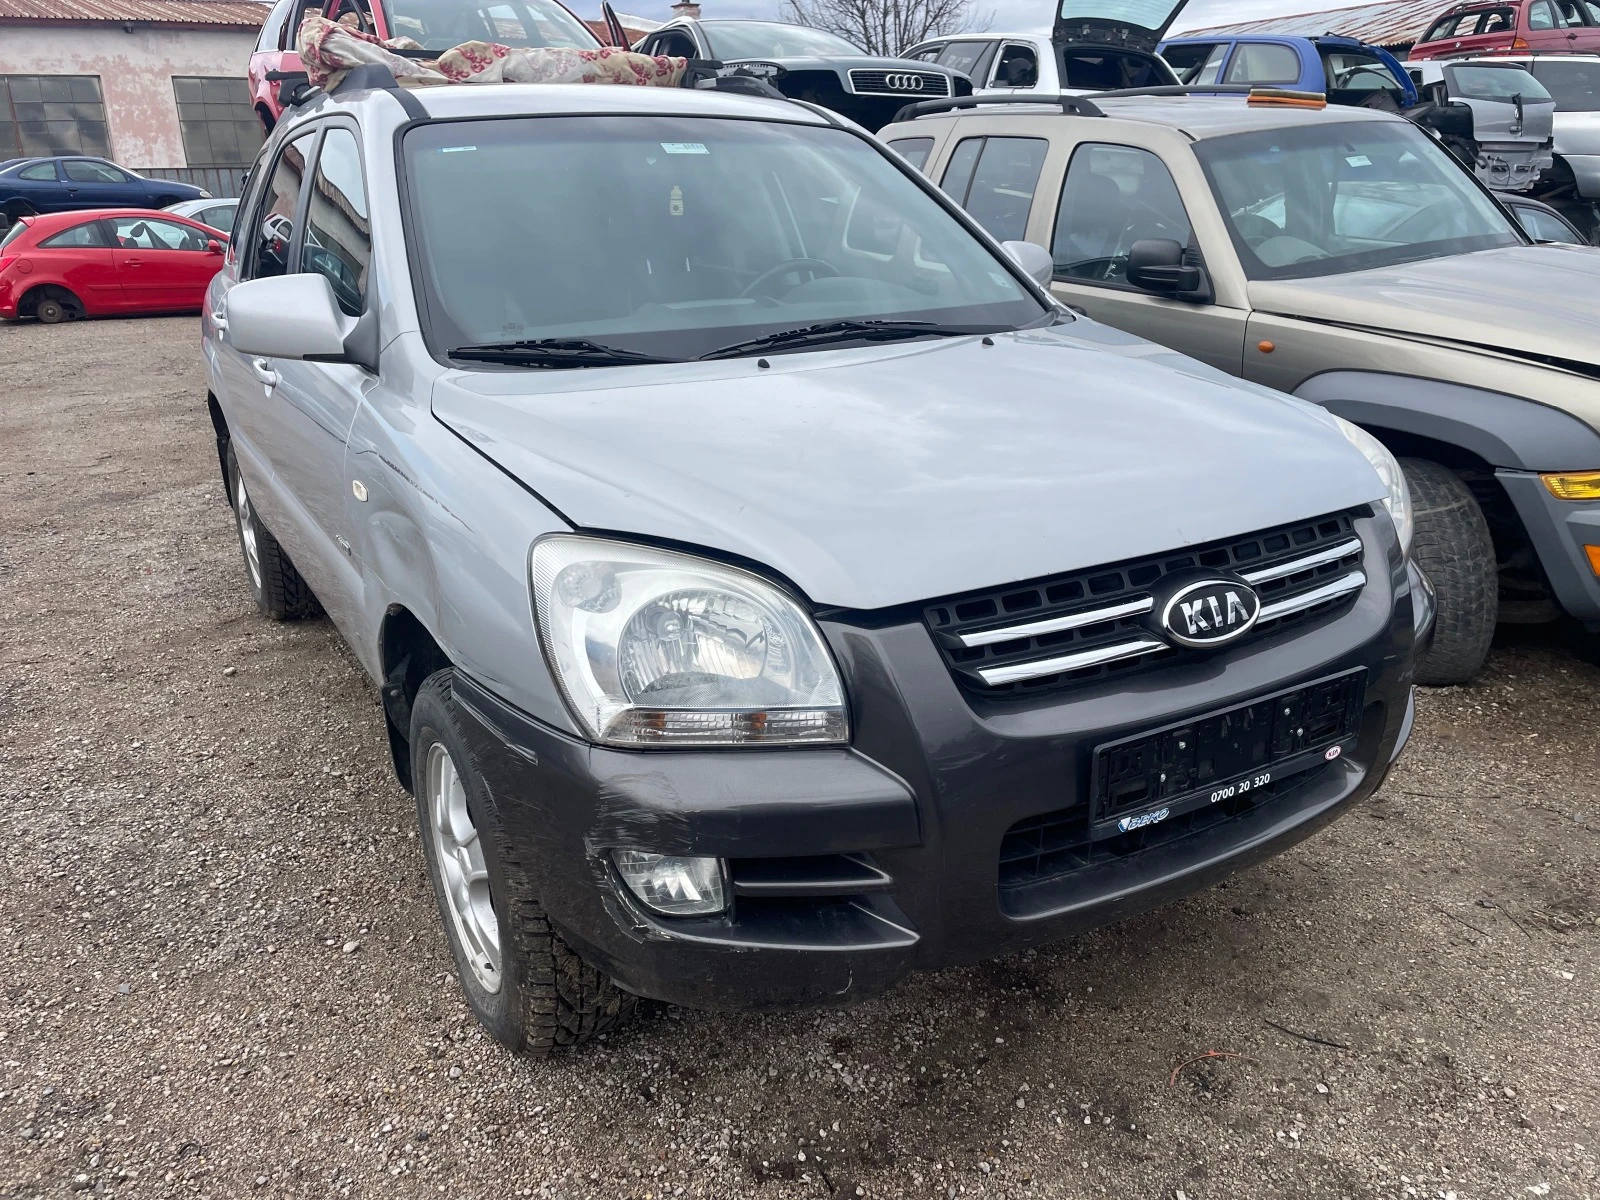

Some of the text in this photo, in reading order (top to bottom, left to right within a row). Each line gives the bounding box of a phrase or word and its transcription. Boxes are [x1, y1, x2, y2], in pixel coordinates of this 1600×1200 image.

[1180, 591, 1250, 635] KIA
[1211, 773, 1271, 803] 0700 20 320
[1128, 808, 1170, 831] BEKO
